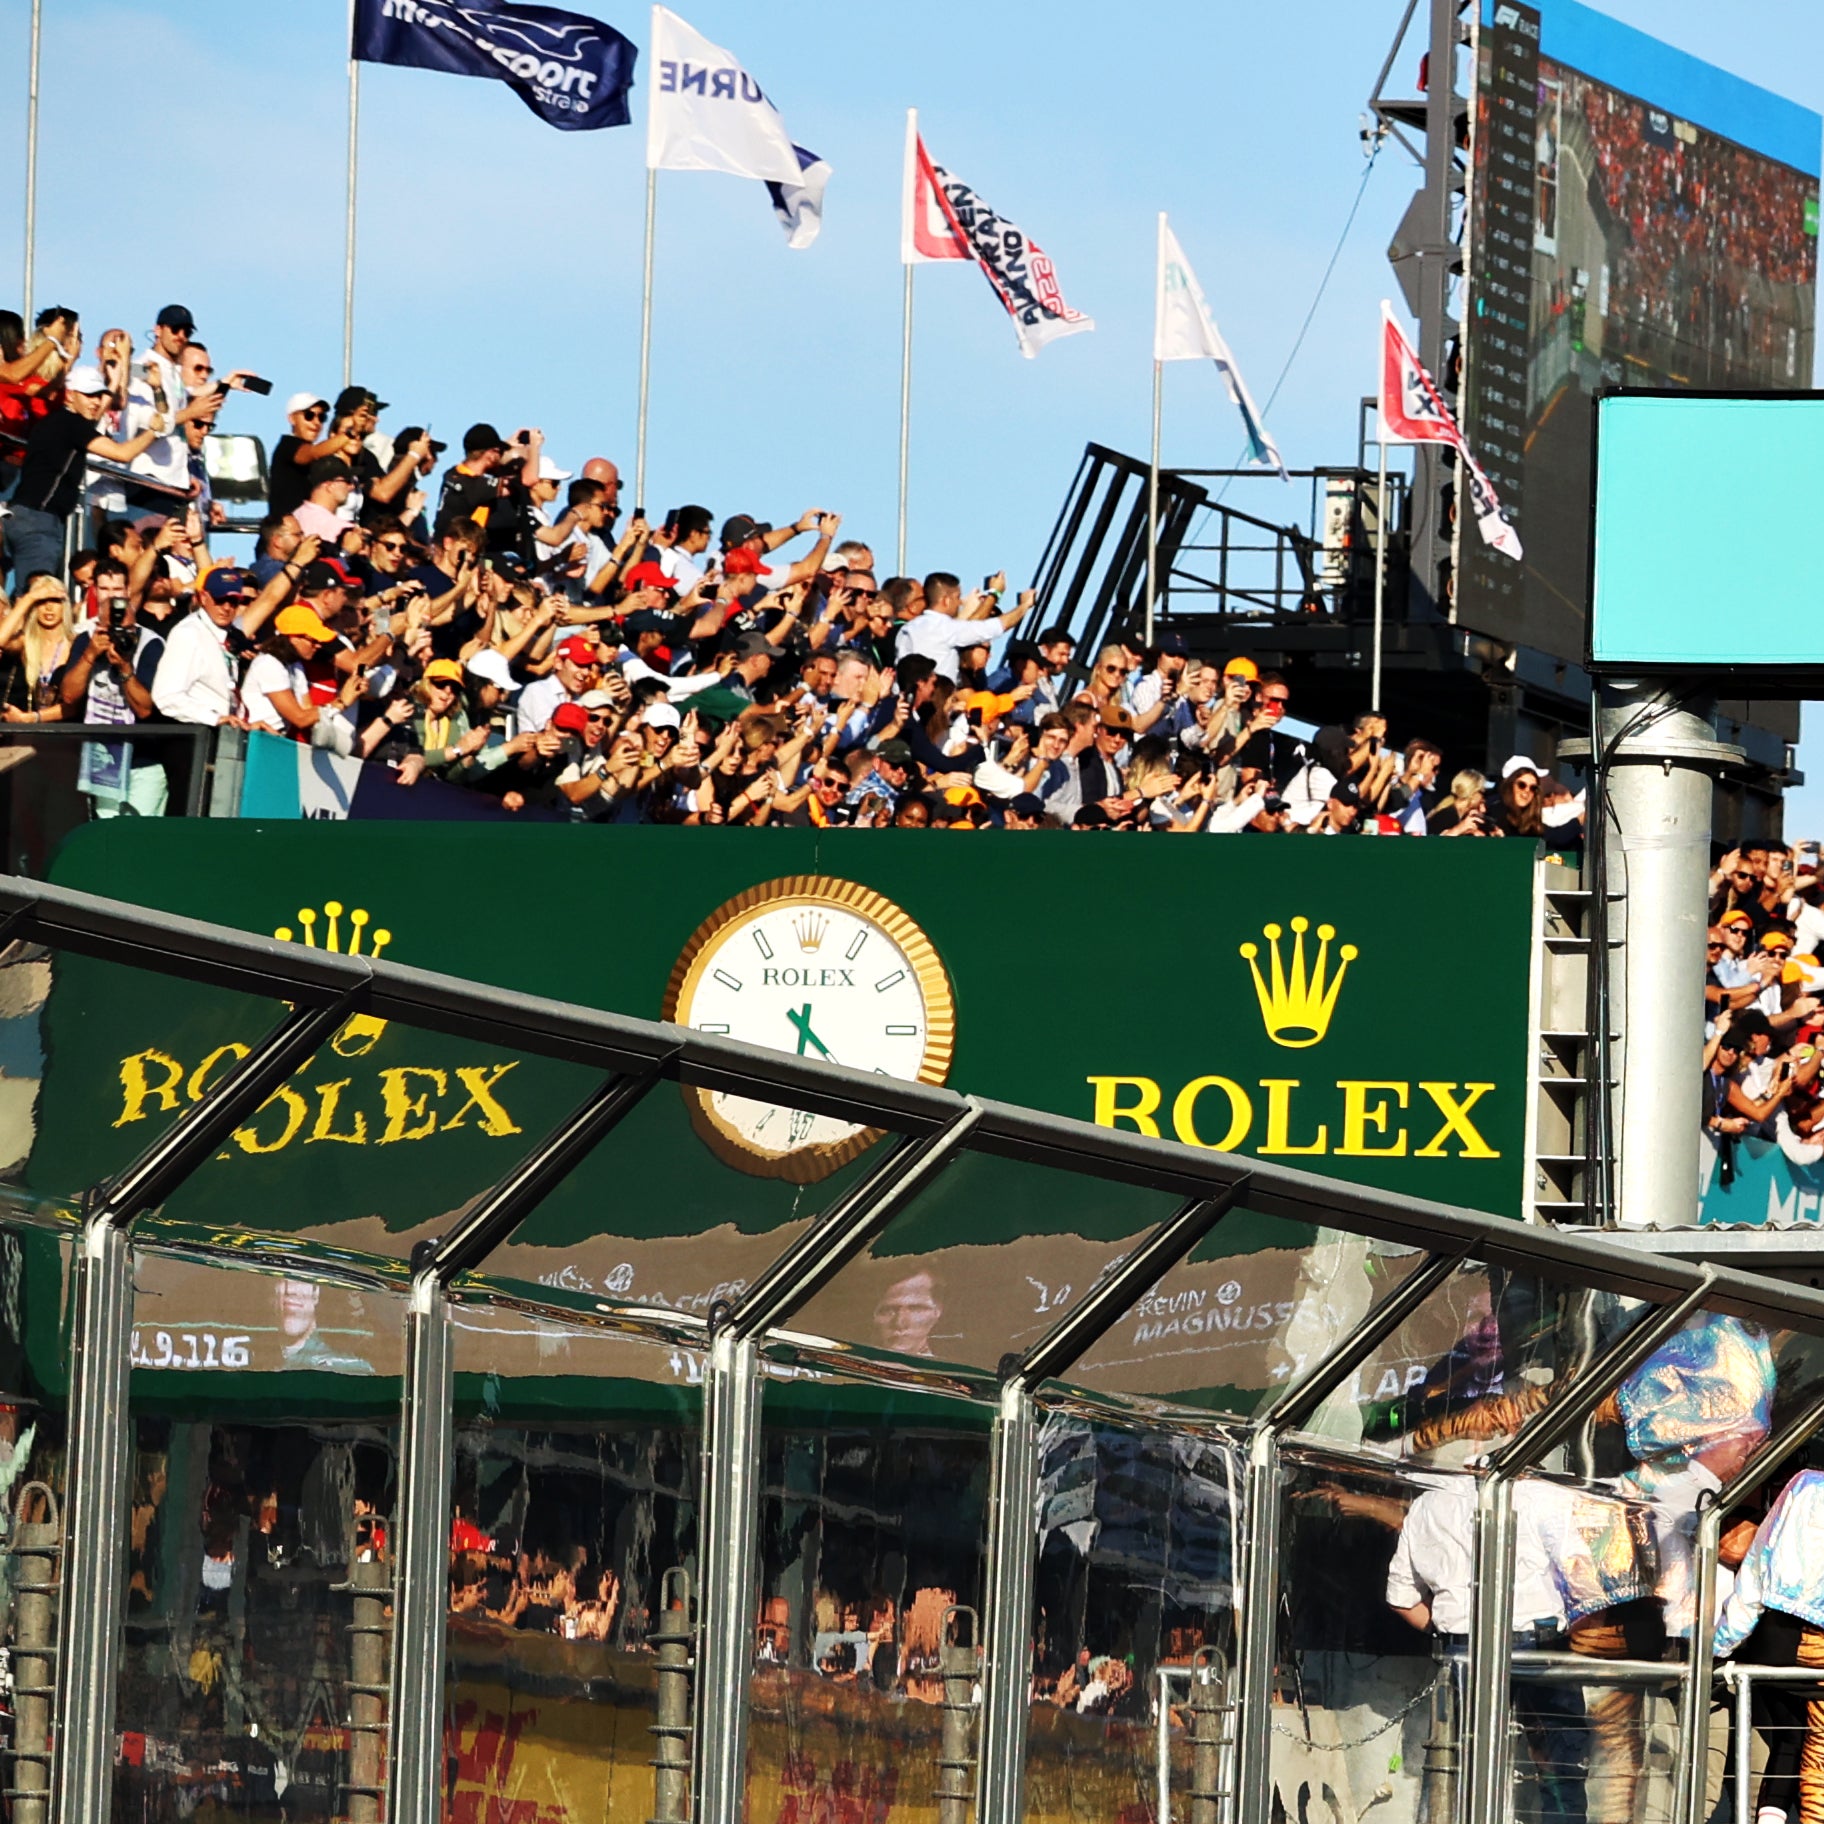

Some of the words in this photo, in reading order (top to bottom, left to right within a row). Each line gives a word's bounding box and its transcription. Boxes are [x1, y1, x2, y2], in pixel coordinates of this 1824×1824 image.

[762, 967, 856, 987] ROLEX
[1086, 1075, 1501, 1158] ROLEX
[1347, 1365, 1428, 1403] LAP
